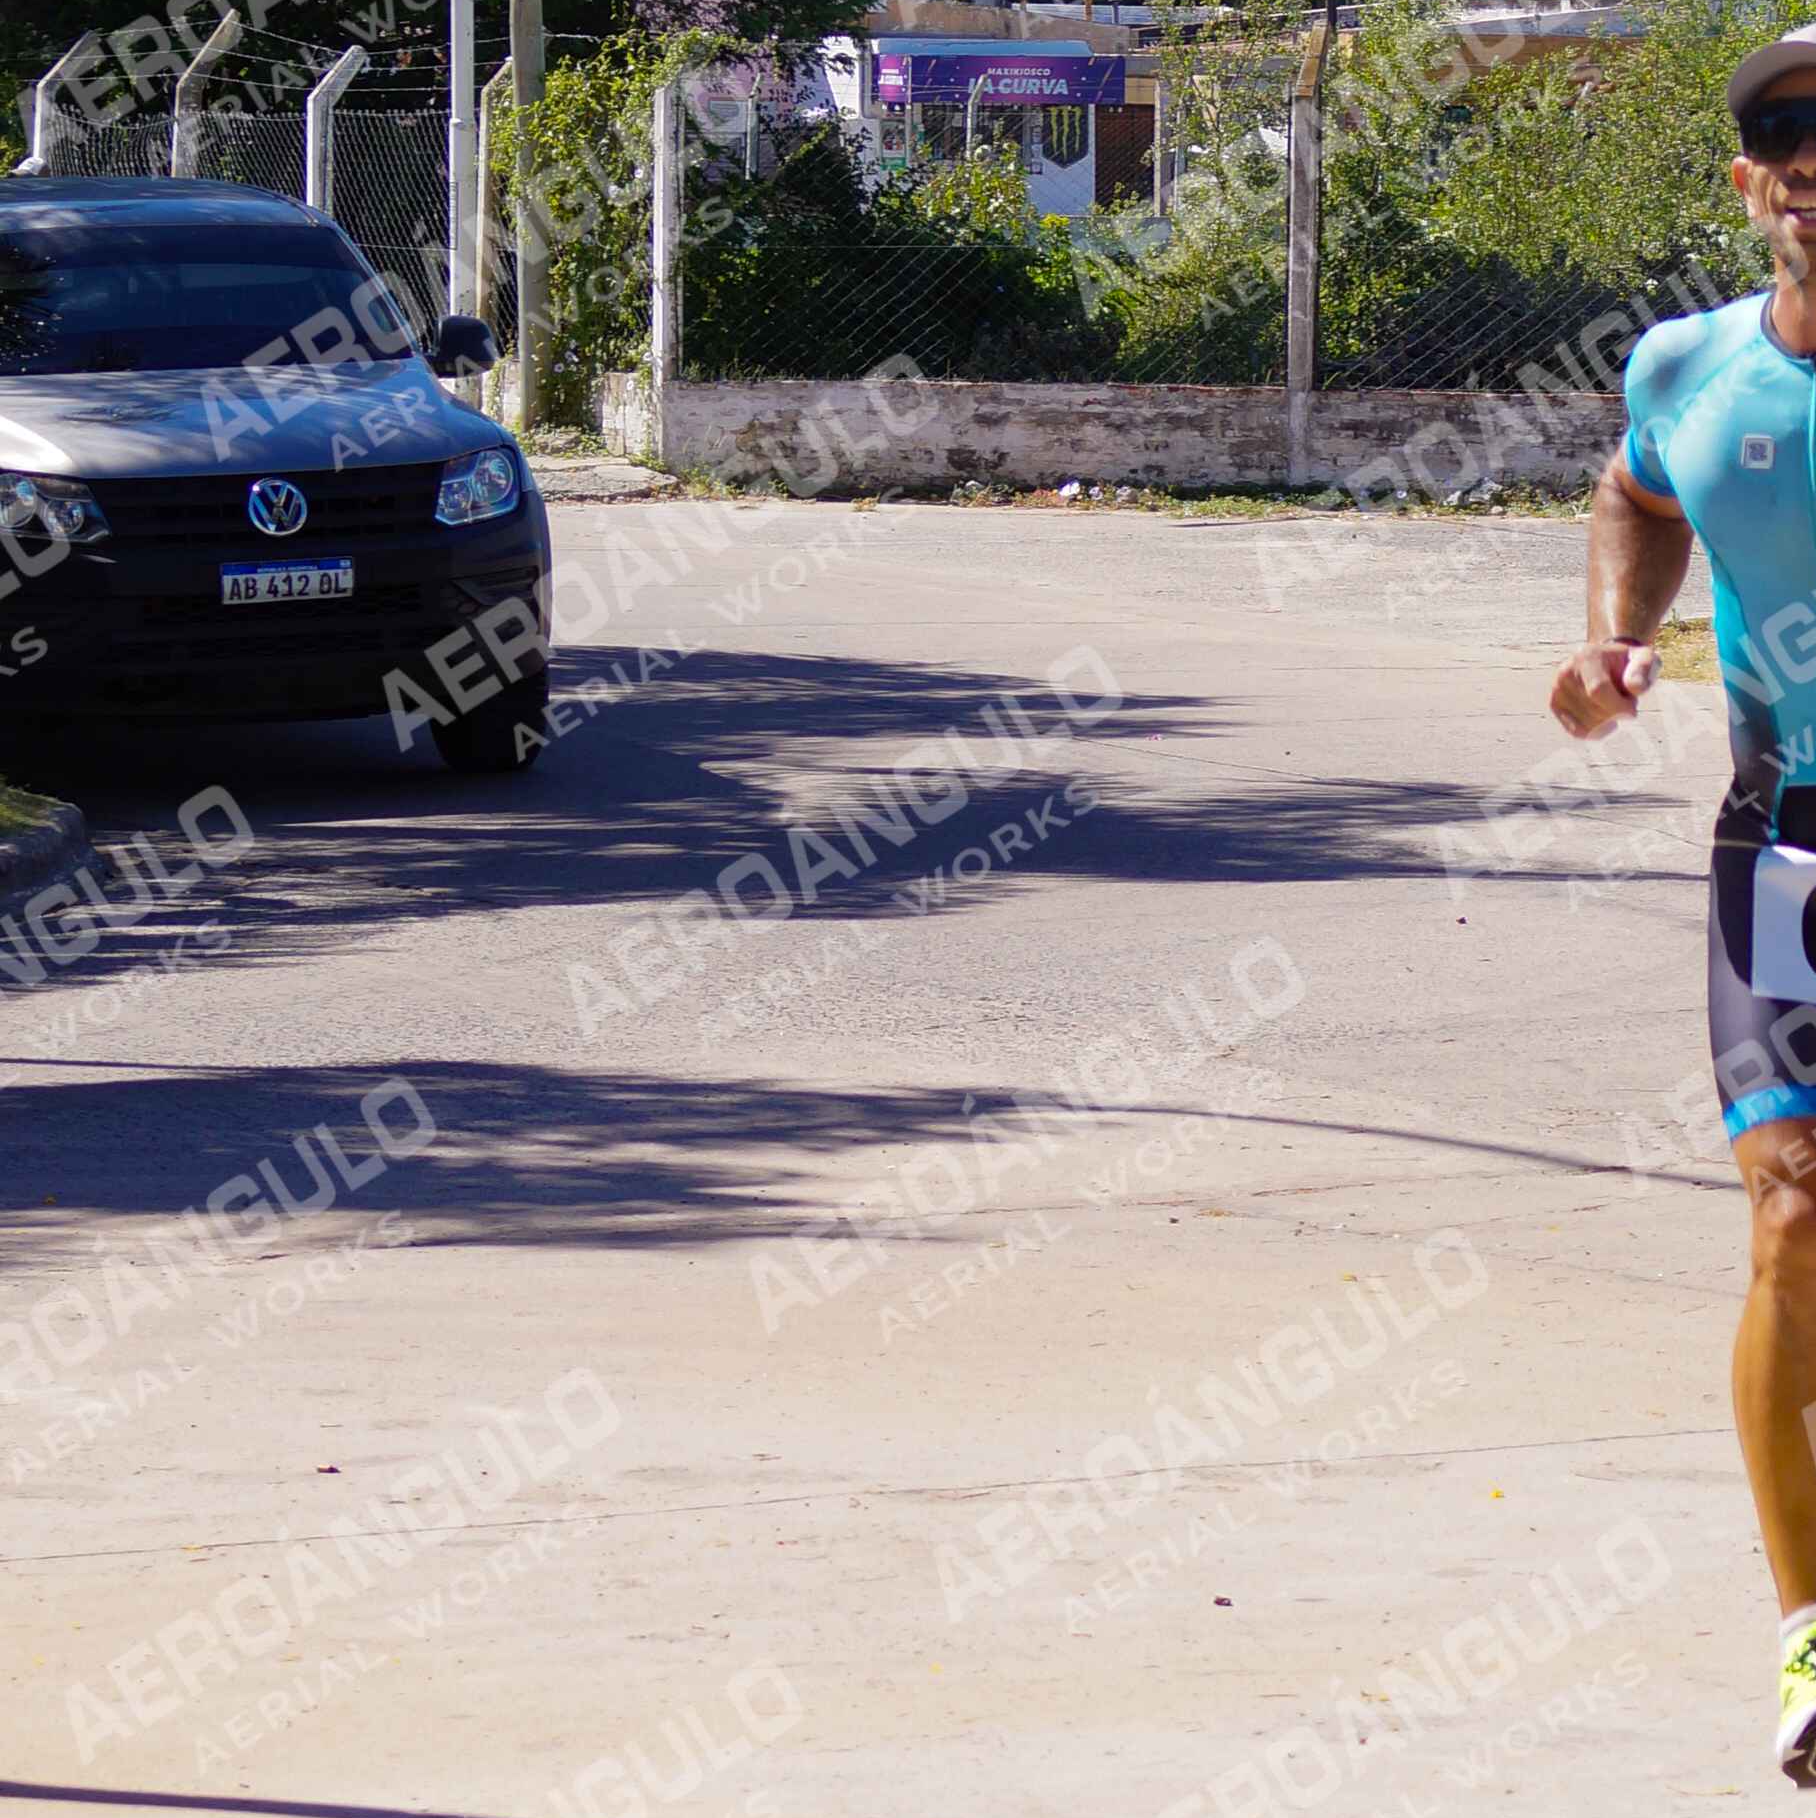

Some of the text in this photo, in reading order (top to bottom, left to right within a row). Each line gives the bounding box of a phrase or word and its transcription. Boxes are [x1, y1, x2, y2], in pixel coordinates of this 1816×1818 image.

[987, 68, 1051, 76] MAXIKIOSCO
[998, 78, 1069, 95] CURVA
[229, 577, 257, 600] AB
[266, 573, 310, 597] 412
